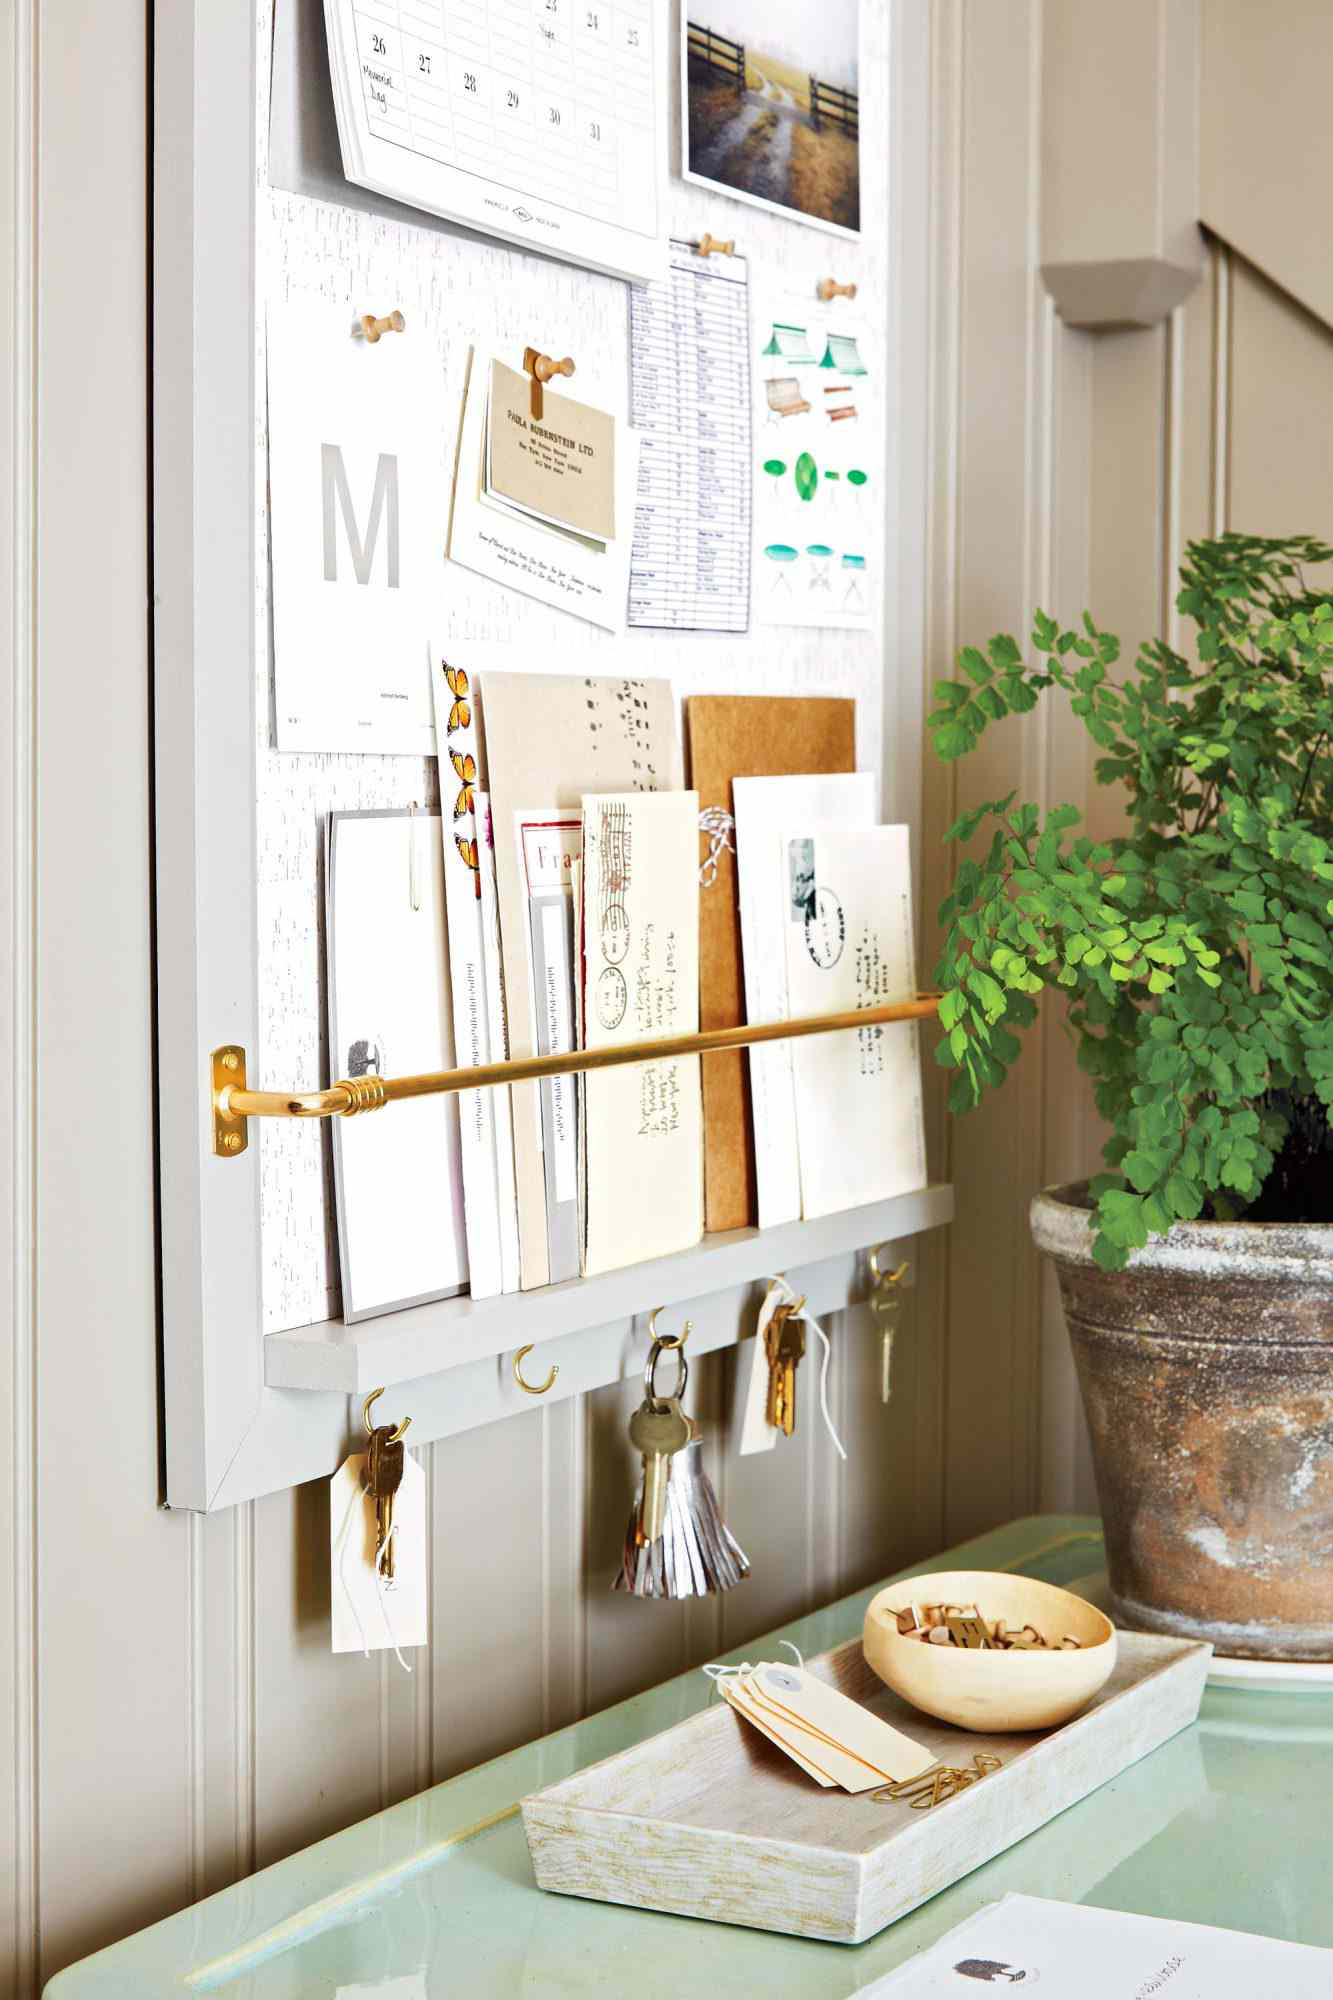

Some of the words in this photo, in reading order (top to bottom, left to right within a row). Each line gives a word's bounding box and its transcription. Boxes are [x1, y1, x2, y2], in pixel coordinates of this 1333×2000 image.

[373, 34, 386, 56] 26
[418, 54, 432, 75] 27
[464, 72, 477, 93] 28
[507, 90, 519, 109] 29
[549, 107, 561, 126] 30
[590, 123, 601, 141] 31
[507, 409, 527, 429] PAULA
[530, 423, 576, 449] RUBENSTEIN
[578, 443, 594, 457] LTD
[321, 443, 400, 589] M
